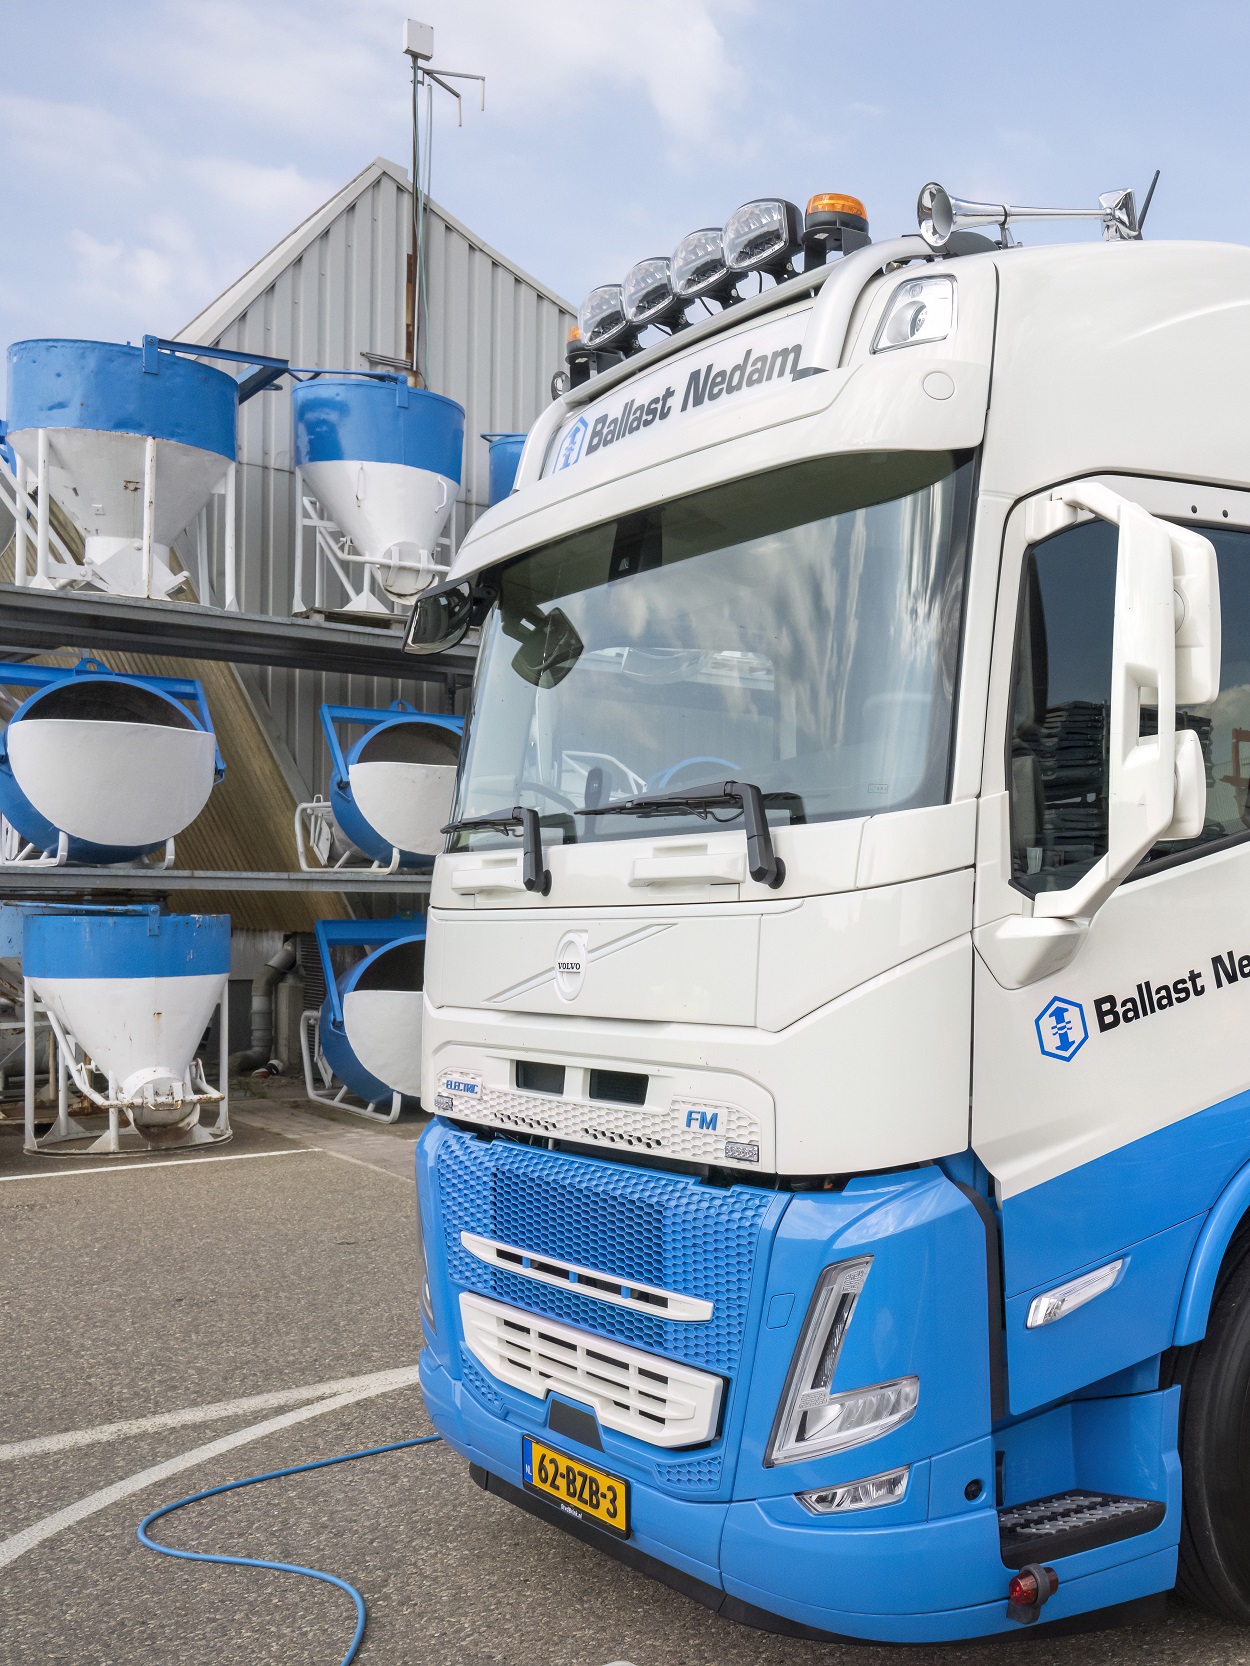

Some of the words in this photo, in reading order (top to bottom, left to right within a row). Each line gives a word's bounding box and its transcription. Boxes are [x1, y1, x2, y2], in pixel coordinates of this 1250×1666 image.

[586, 386, 675, 456] Ballast
[680, 343, 803, 412] Nedam
[557, 962, 581, 971] VOLVO
[1093, 968, 1206, 1034] Ballast
[445, 1079, 479, 1095] ELECTRIC
[685, 1109, 719, 1132] FM
[525, 1464, 532, 1476] NL
[537, 1453, 618, 1519] 62-BZB-3
